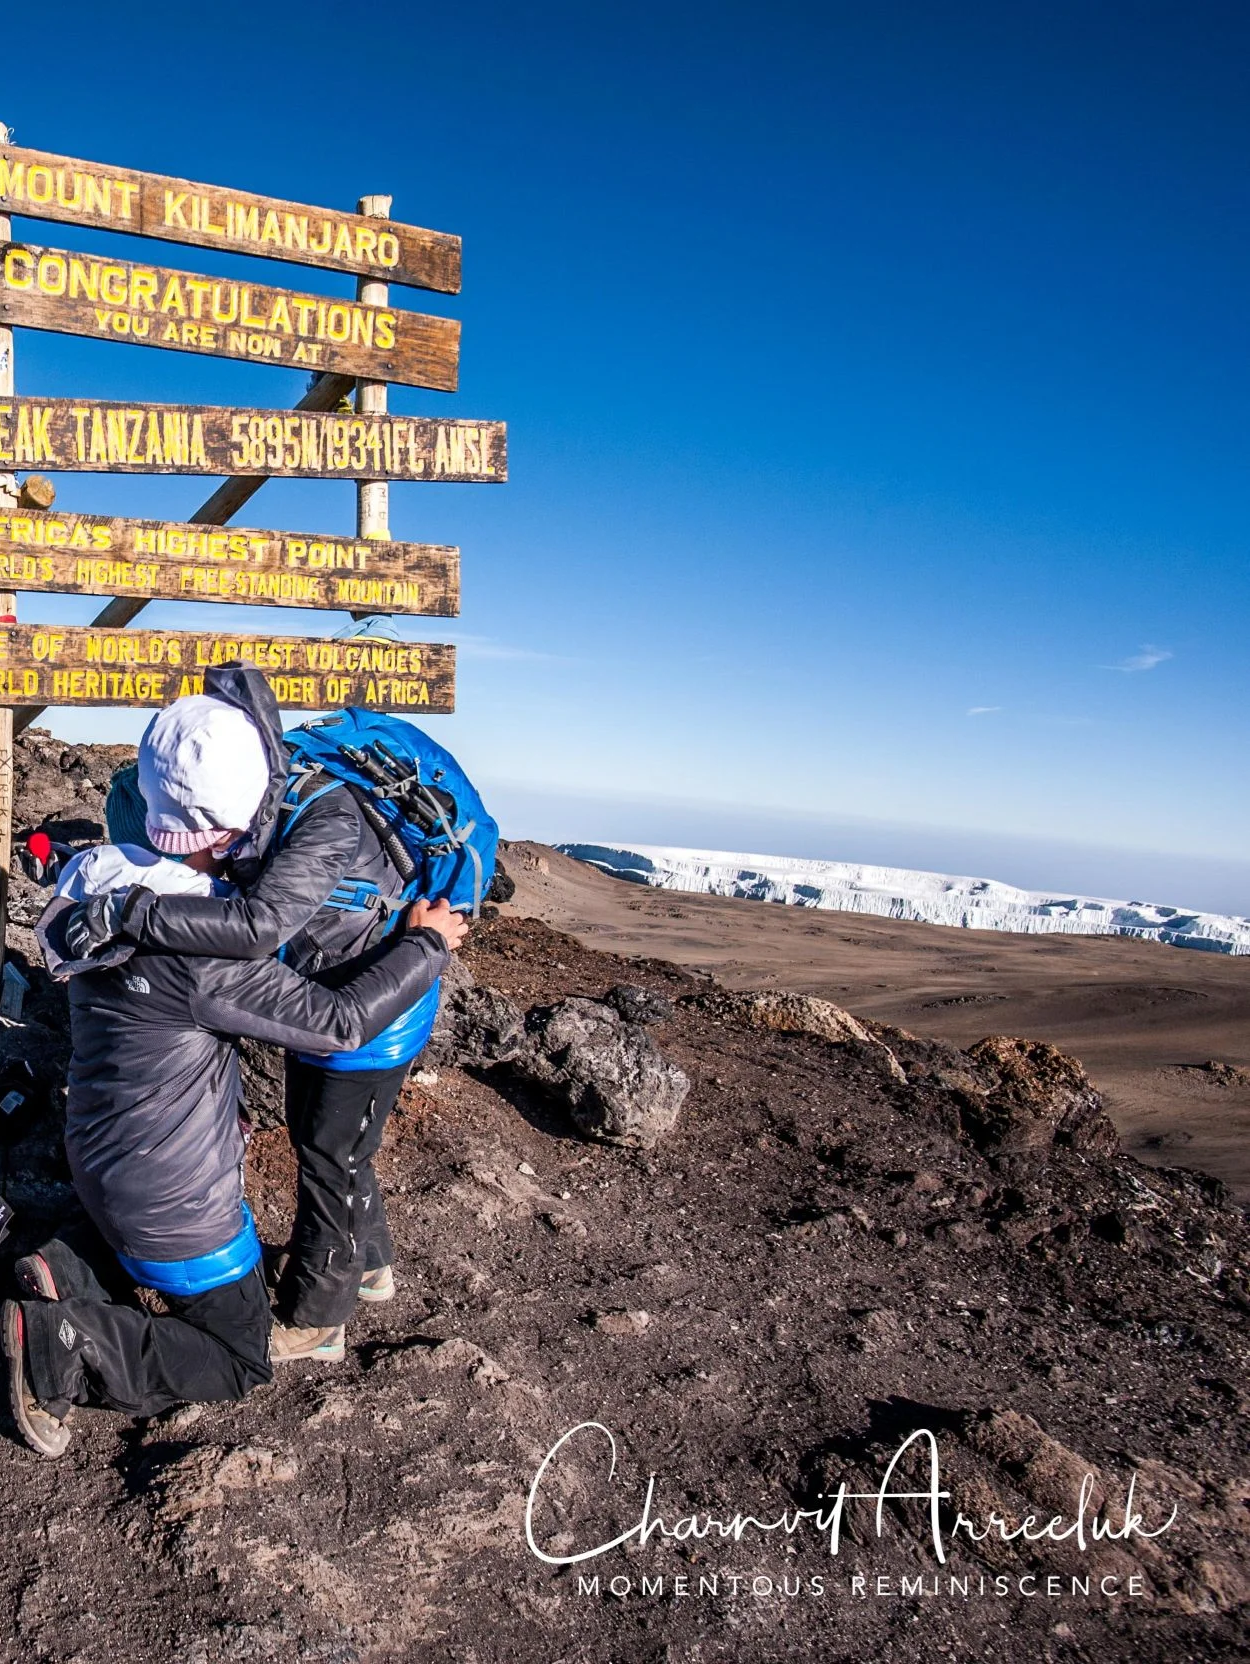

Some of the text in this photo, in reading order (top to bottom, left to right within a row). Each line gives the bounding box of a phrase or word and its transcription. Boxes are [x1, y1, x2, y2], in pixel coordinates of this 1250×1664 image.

[163, 189, 400, 269] KILIMANJARO
[3, 248, 398, 350] CONGRATULATIONS
[95, 308, 323, 364] YOU ARE NOW AT
[134, 528, 270, 563] HIGHEST
[287, 540, 372, 570] POINT
[75, 558, 161, 589] HIGHEST
[338, 578, 419, 606] MOUNTAIN
[31, 633, 64, 662] OF
[306, 643, 423, 675] VOLCANOES
[53, 670, 165, 700] HERITAGE
[326, 678, 352, 704] OF
[364, 678, 431, 706] AFRICA
